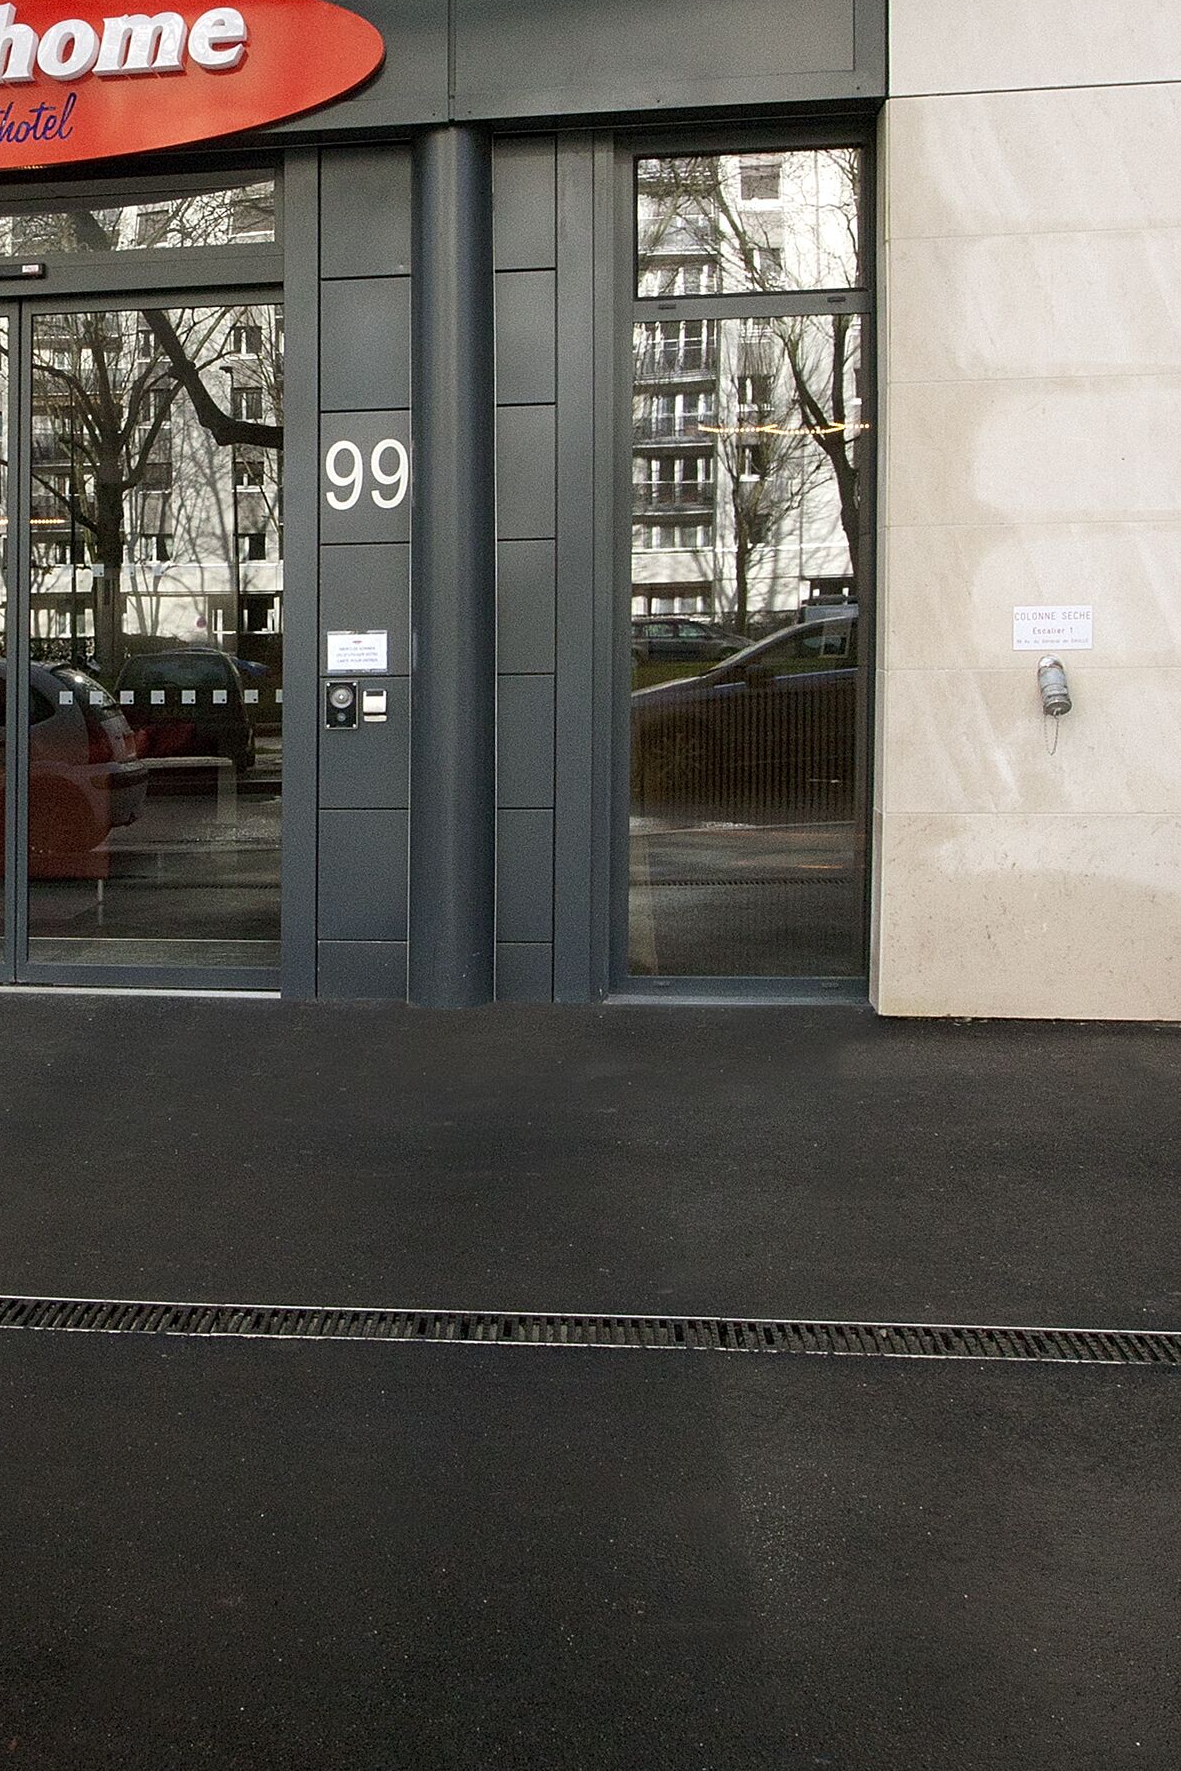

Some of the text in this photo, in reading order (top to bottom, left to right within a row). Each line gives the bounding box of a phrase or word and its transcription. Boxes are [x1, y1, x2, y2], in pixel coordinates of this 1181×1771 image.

[325, 438, 409, 511] 99
[1014, 611, 1091, 621] COLONNE SECHE
[1032, 627, 1065, 635] Escalier
